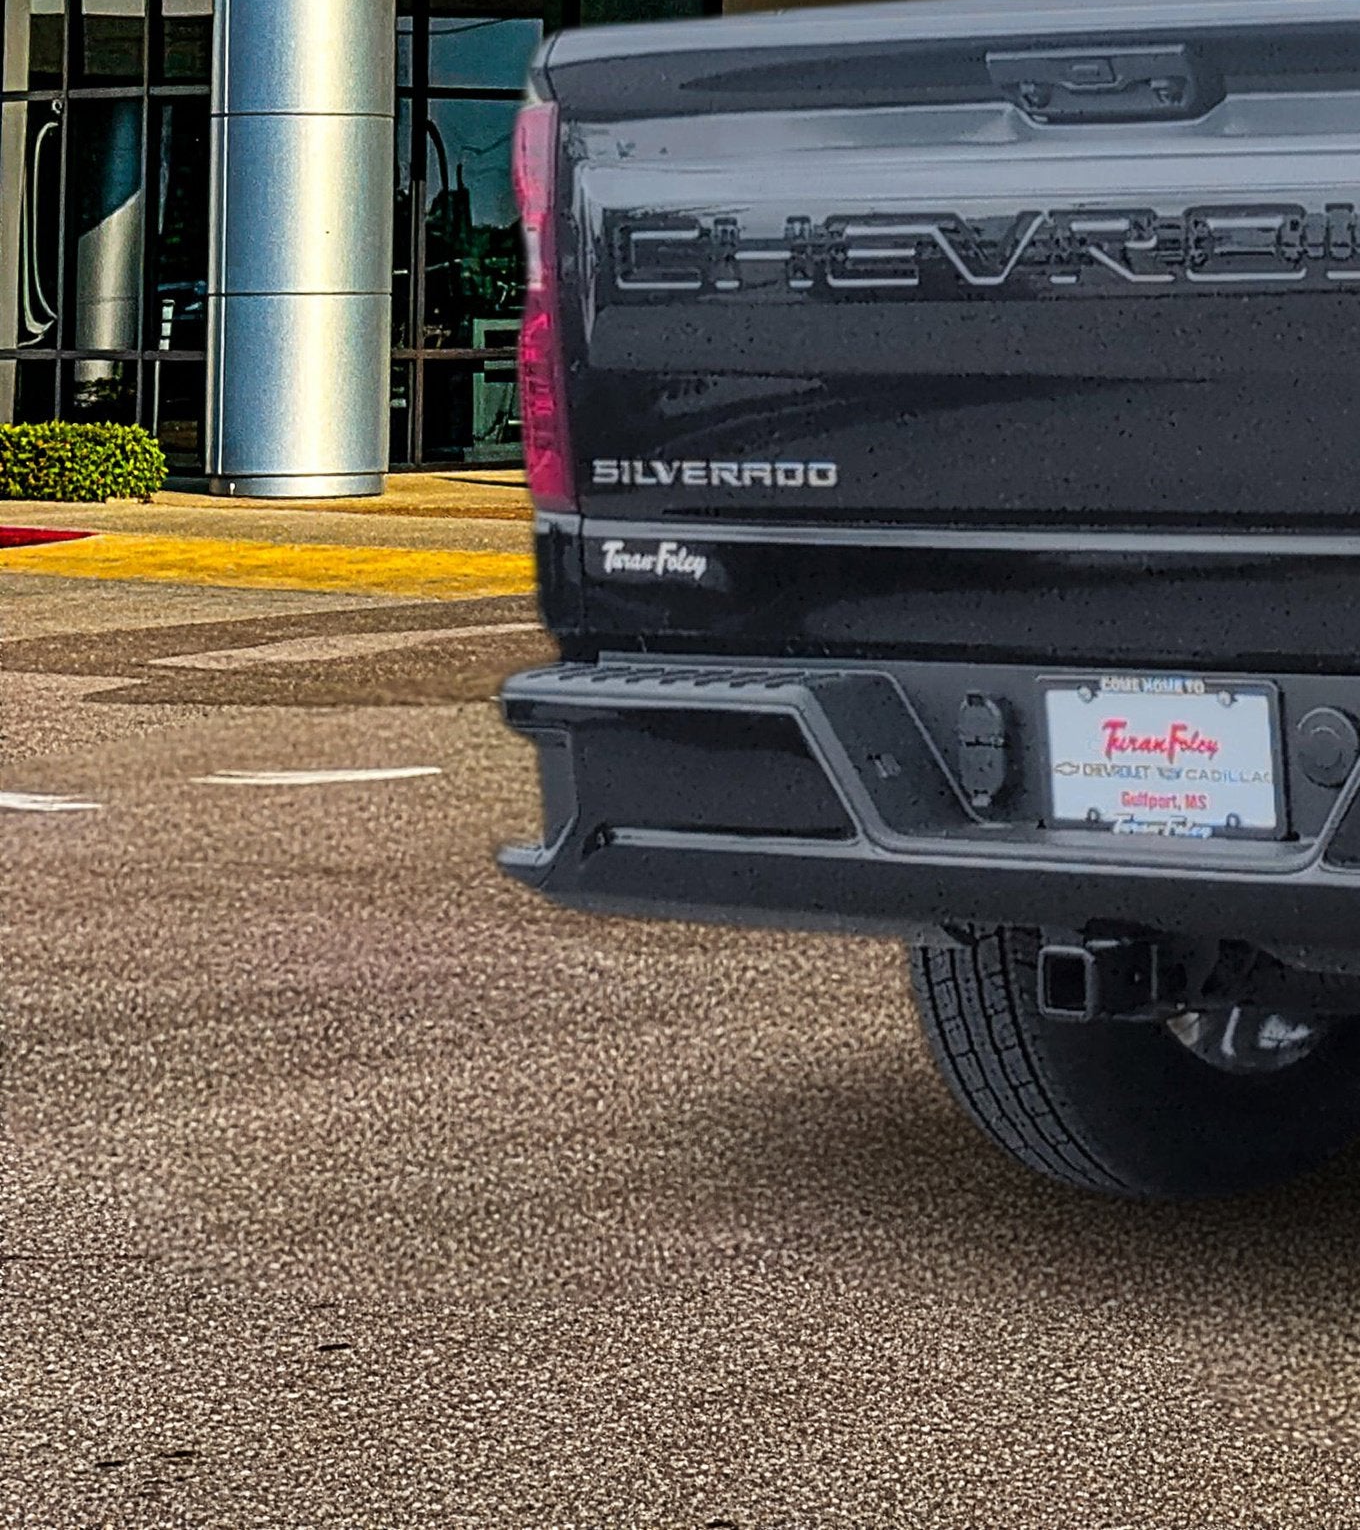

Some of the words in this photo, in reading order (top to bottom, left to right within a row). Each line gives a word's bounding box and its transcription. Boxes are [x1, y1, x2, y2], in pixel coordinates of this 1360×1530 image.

[592, 458, 838, 488] SILVERADO
[601, 539, 657, 574] Turan
[655, 541, 707, 581] Foley
[1102, 719, 1167, 761] Turan
[1167, 722, 1219, 765] Foley
[1121, 790, 1181, 811] Gulfport,
[1184, 794, 1208, 810] MS
